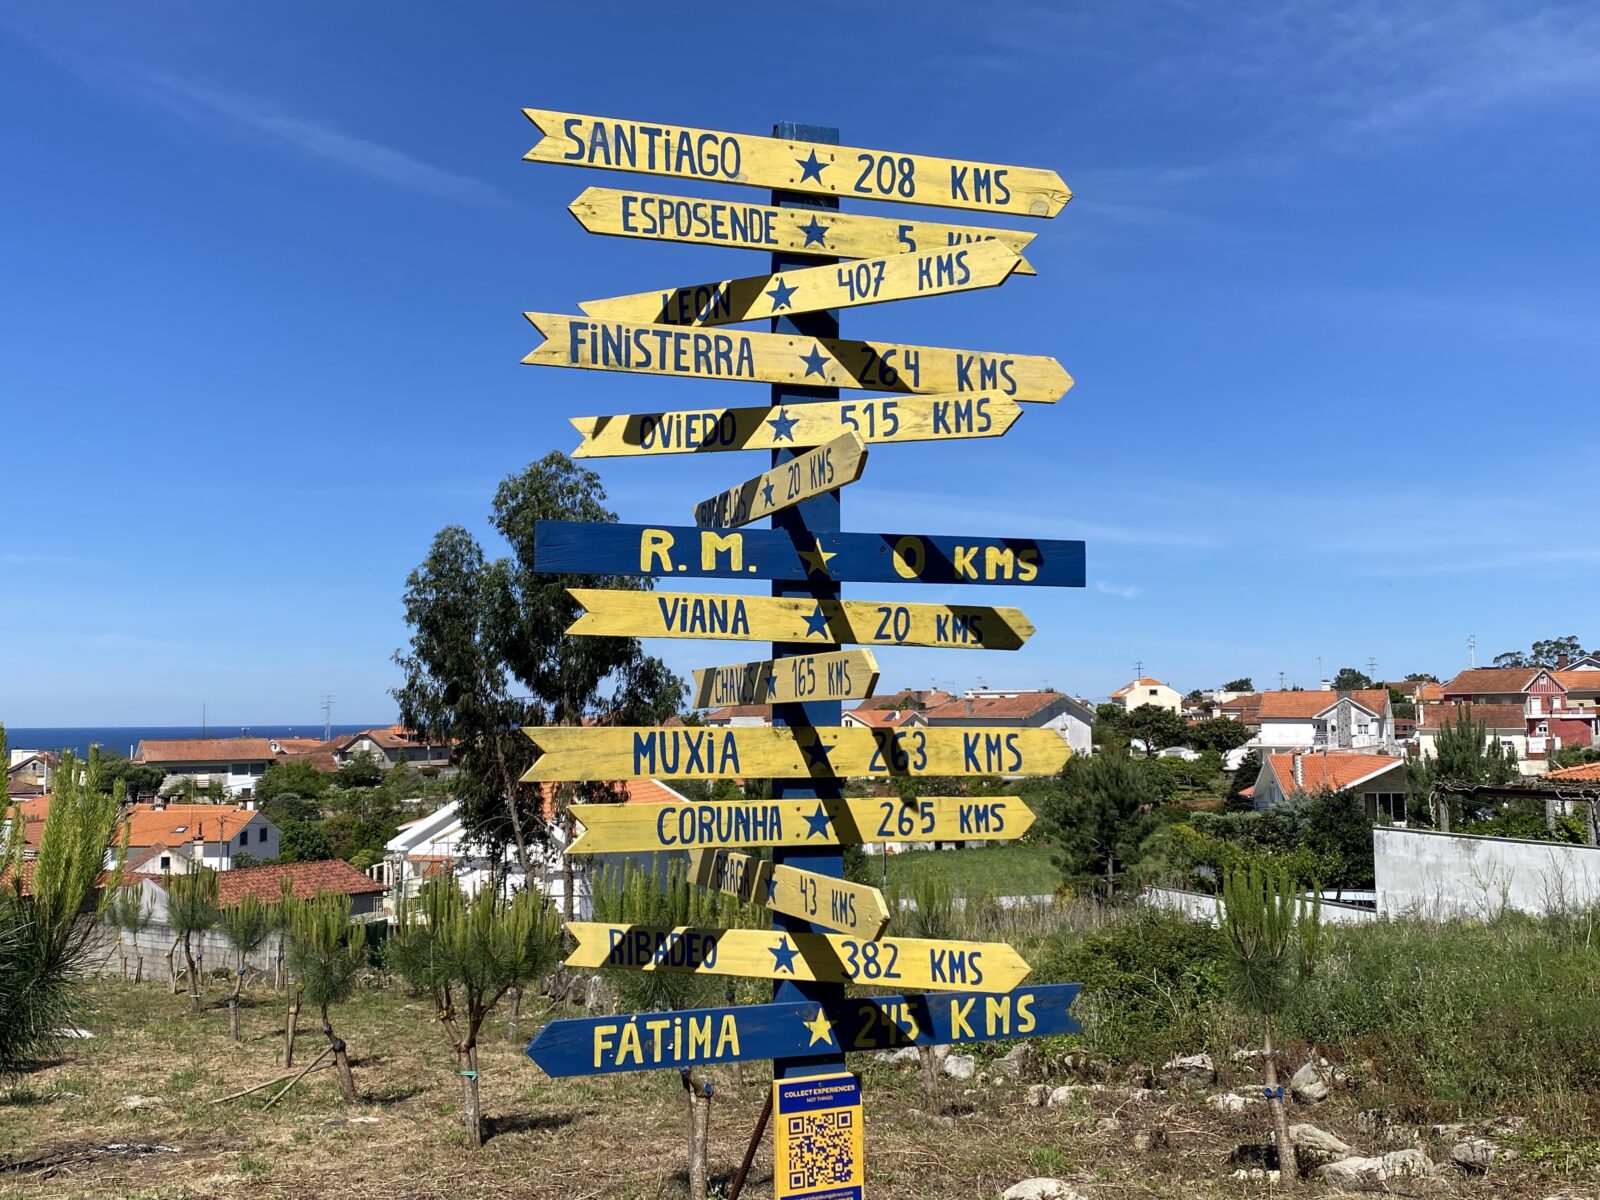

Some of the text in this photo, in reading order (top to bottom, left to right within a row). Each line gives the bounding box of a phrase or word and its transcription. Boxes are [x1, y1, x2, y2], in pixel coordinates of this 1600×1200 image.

[854, 153, 915, 198] 208
[950, 165, 1011, 205] KMS
[622, 196, 917, 254] ESPOSENDE 5
[662, 250, 971, 324] LEON 407 KMS
[858, 346, 920, 388] 264
[956, 354, 1017, 396] KMS
[841, 401, 899, 438] 515
[933, 397, 992, 435] KMS
[701, 447, 834, 528] BARCELOS 20 KMS
[954, 546, 1039, 581] KMS
[874, 606, 911, 642] 20
[936, 614, 983, 645] KMS
[715, 658, 851, 704] CHAVES 165 KMS
[869, 731, 928, 772] 263
[963, 732, 1023, 773] KMS
[657, 802, 1006, 845] CORUNHA 265 KMS
[716, 854, 857, 928] BRAGA 43 KMS
[841, 940, 901, 979] 382
[930, 948, 983, 985] KMS
[854, 1003, 920, 1047] 245
[951, 994, 1036, 1040] KMS
[784, 1084, 855, 1098] COLLECT EXPERIENCES
